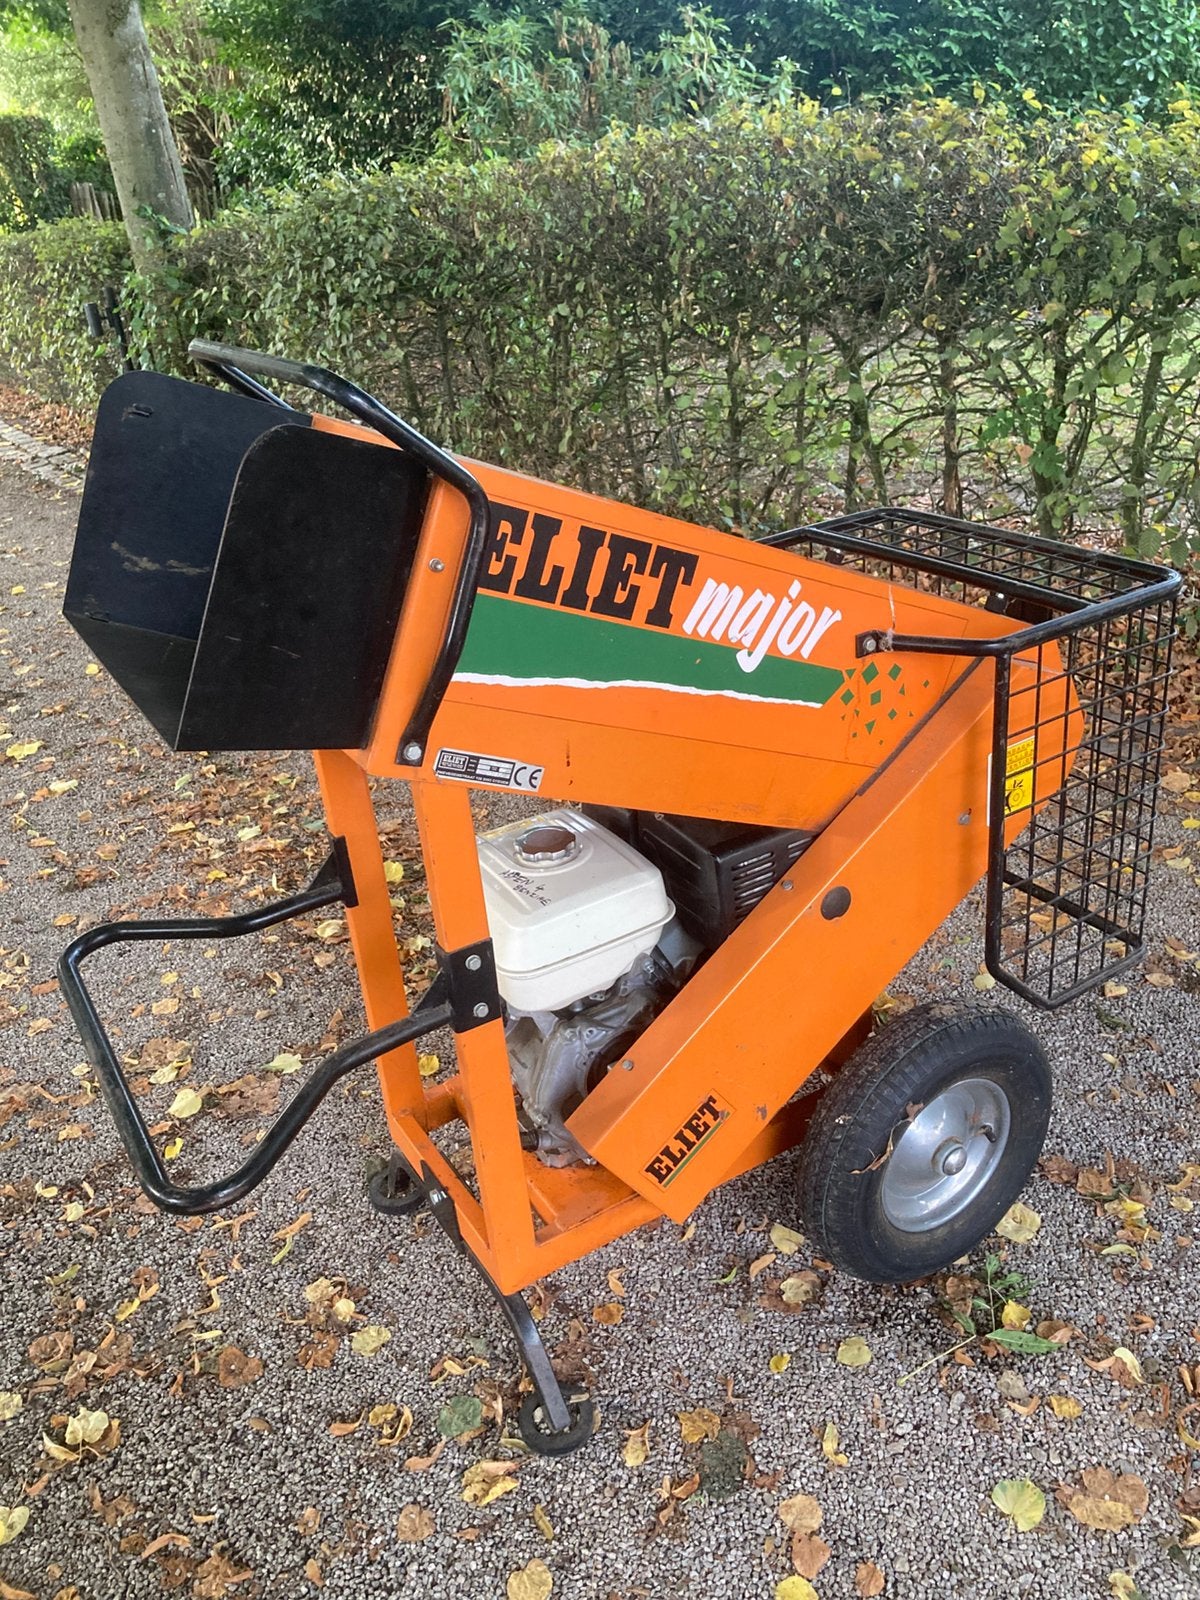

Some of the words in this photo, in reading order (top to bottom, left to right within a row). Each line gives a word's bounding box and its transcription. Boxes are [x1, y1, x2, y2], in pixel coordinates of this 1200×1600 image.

[479, 501, 699, 628] ELIET
[682, 577, 842, 673] major
[443, 754, 466, 766] ELIET
[645, 1095, 720, 1184] ELIET
